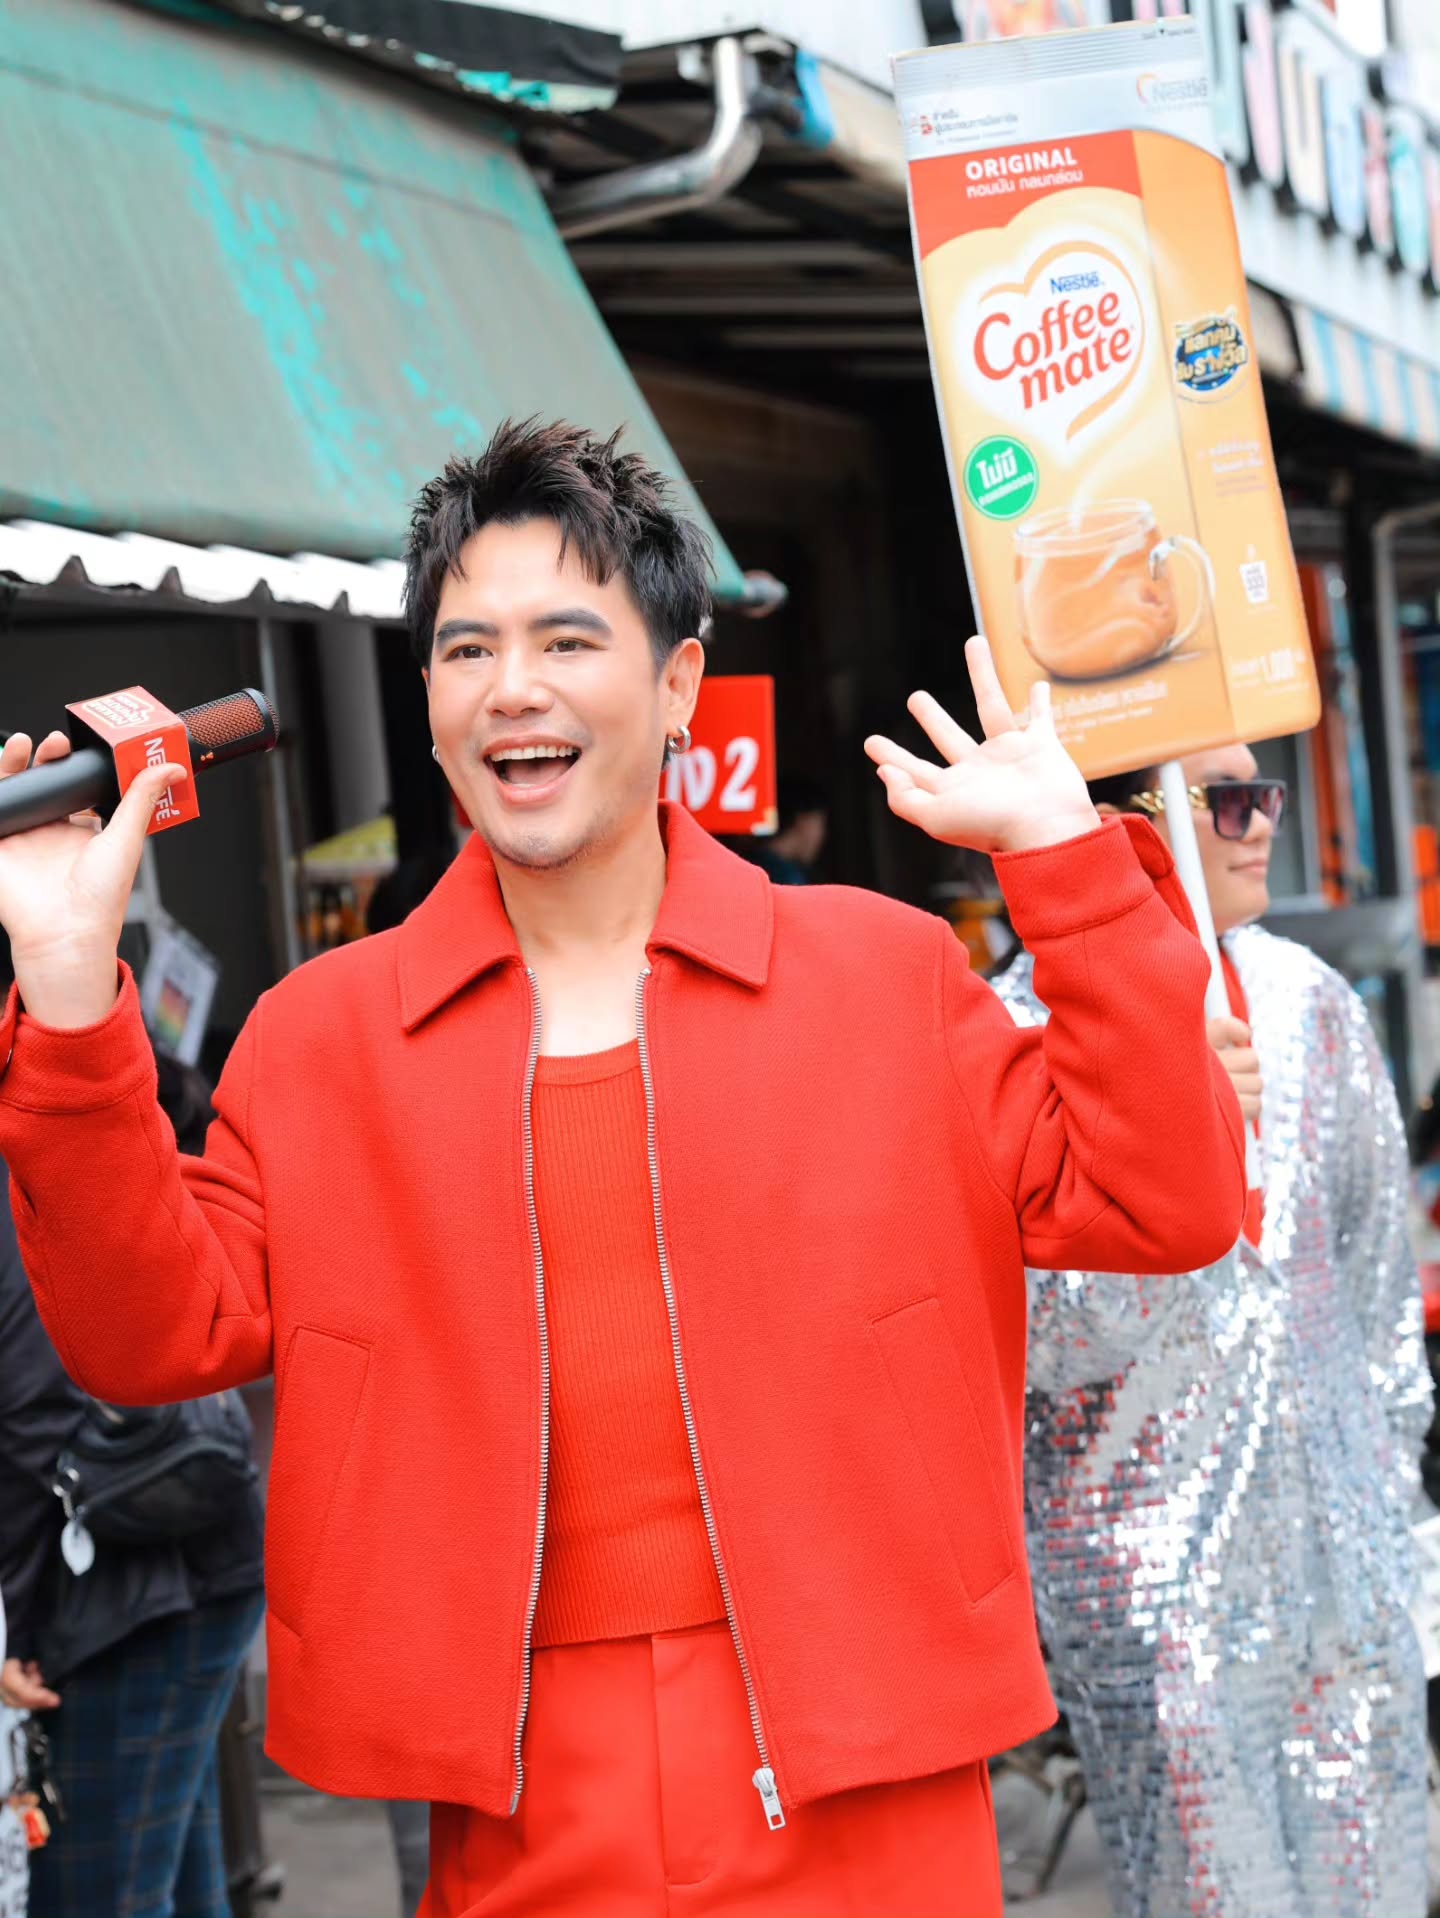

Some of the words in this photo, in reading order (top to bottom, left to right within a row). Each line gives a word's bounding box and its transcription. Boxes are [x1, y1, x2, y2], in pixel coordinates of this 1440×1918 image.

[965, 146, 1078, 181] ORIGINAL
[1019, 168, 1085, 191] กลมกล่อม
[973, 291, 1121, 381] Coffee
[1020, 327, 1133, 411] mate
[976, 446, 1018, 490] ไม่มี
[143, 736, 180, 824] NEFÉ
[719, 736, 760, 812] 2
